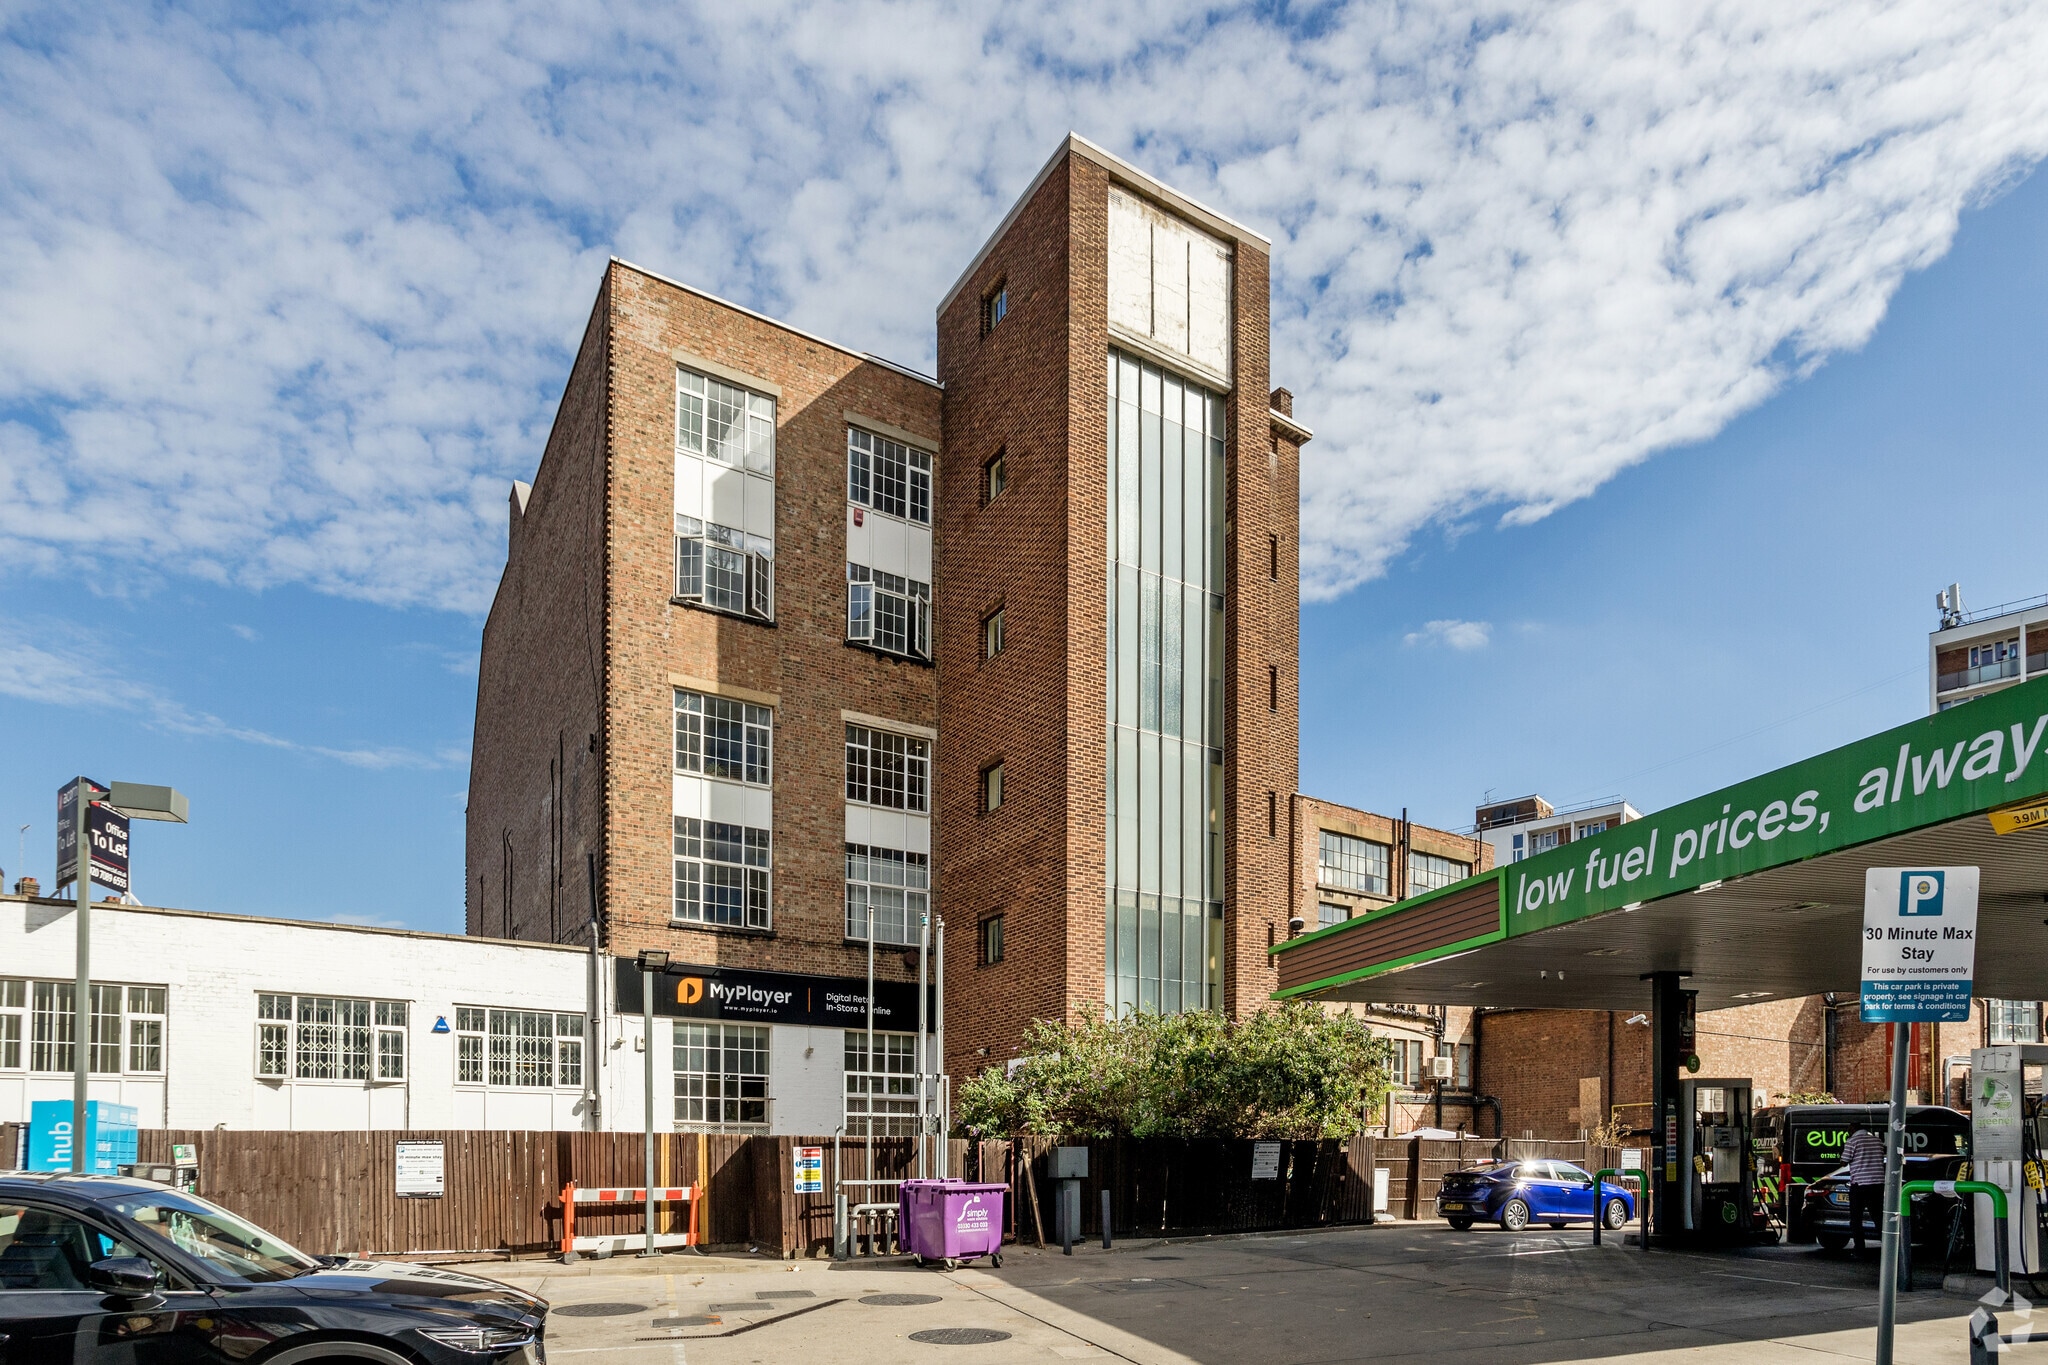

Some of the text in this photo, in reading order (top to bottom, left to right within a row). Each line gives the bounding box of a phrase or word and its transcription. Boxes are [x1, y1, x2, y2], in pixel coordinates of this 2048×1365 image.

[1516, 713, 2048, 915] low fuel prices, alway
[2013, 810, 2041, 824] 3.9M
[105, 822, 128, 841] Office
[91, 829, 128, 859] To Let
[1866, 927, 1973, 940] 30 Minute Max
[1901, 946, 1935, 963] Stay
[1897, 967, 1907, 975] by
[1951, 967, 1968, 975] only
[1873, 983, 1889, 991] This
[1904, 983, 1922, 992] park
[1932, 983, 1960, 992] private
[709, 983, 792, 1007] MyPlayer
[826, 993, 852, 1004] Digital
[1864, 994, 1896, 1002] property,
[1913, 993, 1945, 1001] signage
[724, 1005, 778, 1014] www.myplayer.io
[826, 1003, 859, 1013] In-Store
[859, 1006, 866, 1014] &
[1864, 1002, 1880, 1010] park
[1690, 1058, 1697, 1070] 5
[1975, 1115, 2014, 1129] greener
[48, 1121, 73, 1163] hub
[967, 1208, 988, 1217] simply
